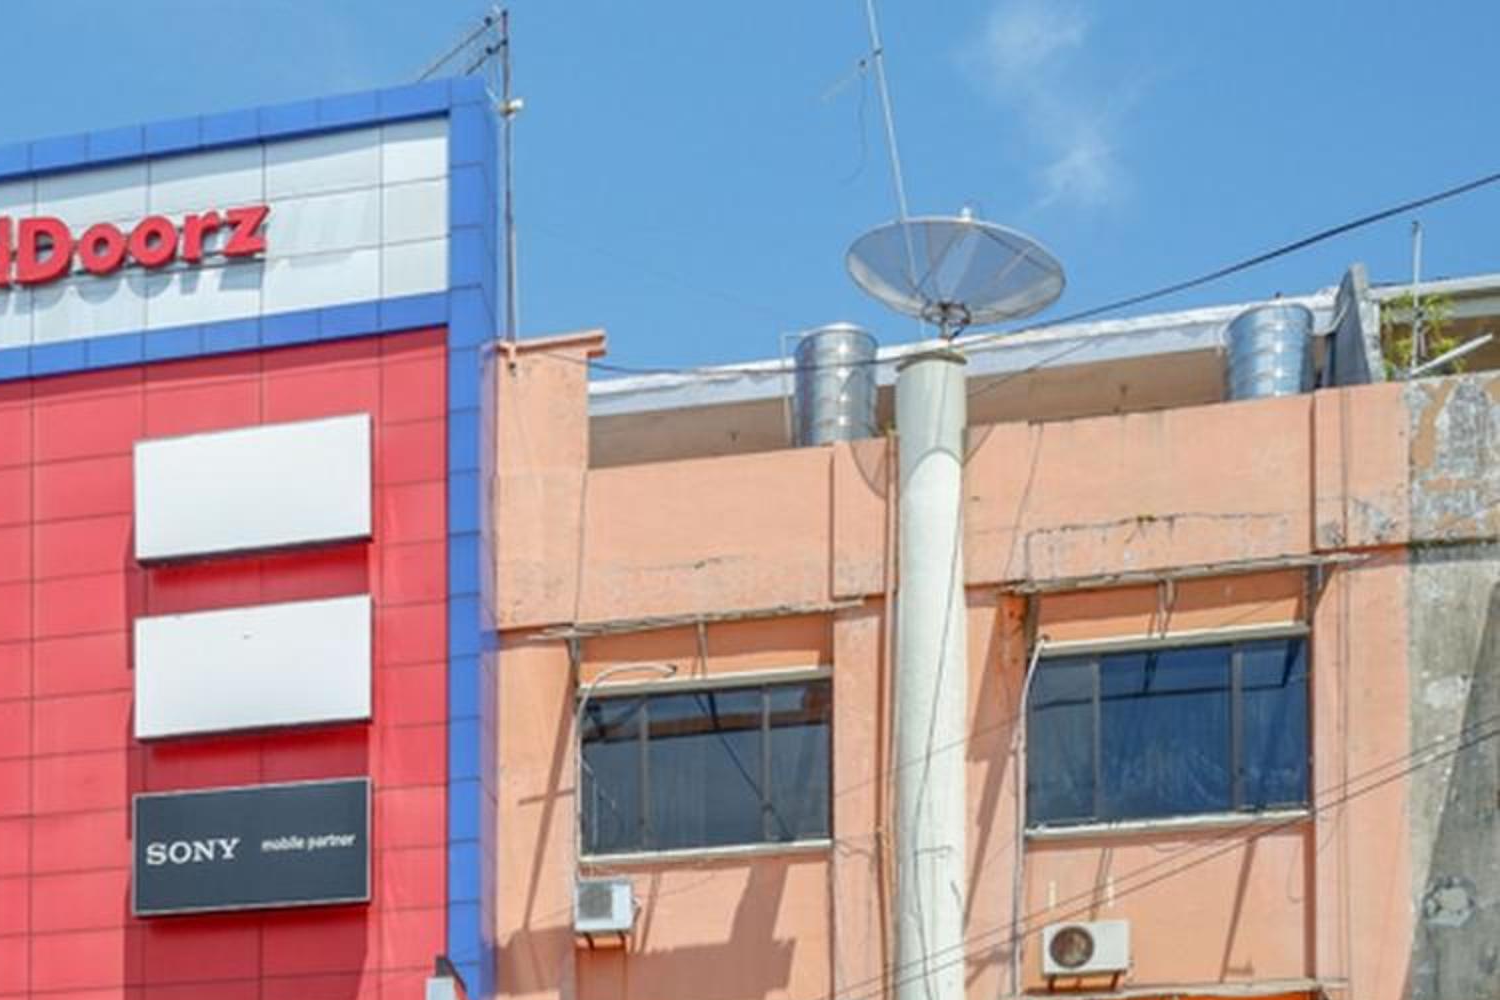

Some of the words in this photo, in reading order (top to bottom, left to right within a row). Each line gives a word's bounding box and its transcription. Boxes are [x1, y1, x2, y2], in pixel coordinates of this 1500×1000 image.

[146, 838, 240, 866] SONY
[261, 836, 304, 851] mobile
[308, 833, 356, 850] partner
